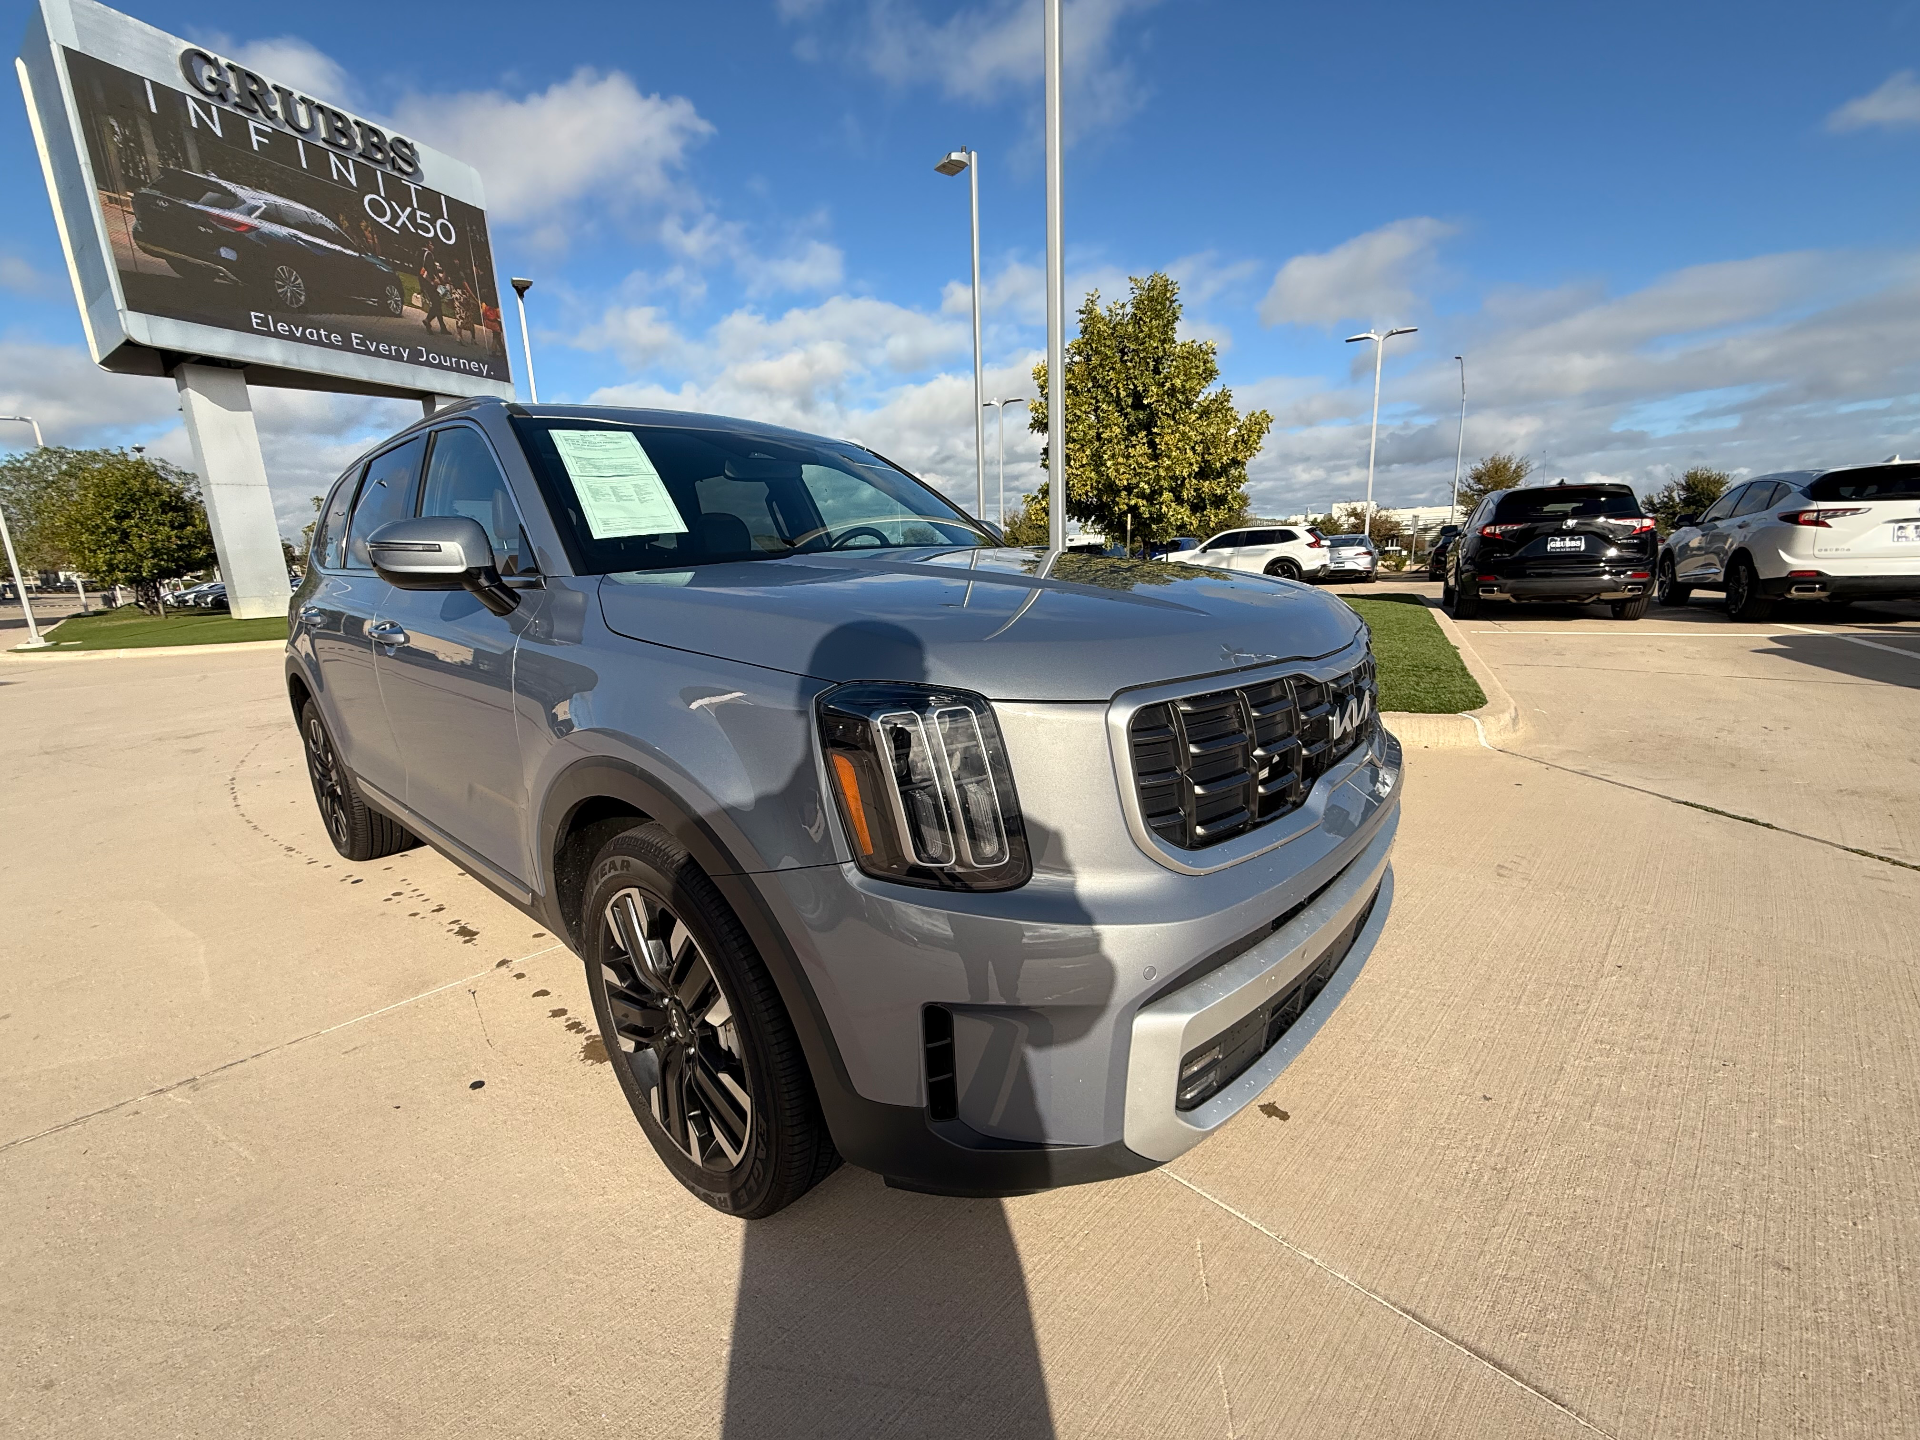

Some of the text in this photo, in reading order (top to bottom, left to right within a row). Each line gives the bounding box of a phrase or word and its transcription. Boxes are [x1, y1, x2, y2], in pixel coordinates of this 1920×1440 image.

[144, 79, 448, 219] INFINITI
[179, 48, 420, 176] GRUBBS
[363, 193, 456, 245] QX50
[250, 311, 495, 376] Elevate Every Journey.
